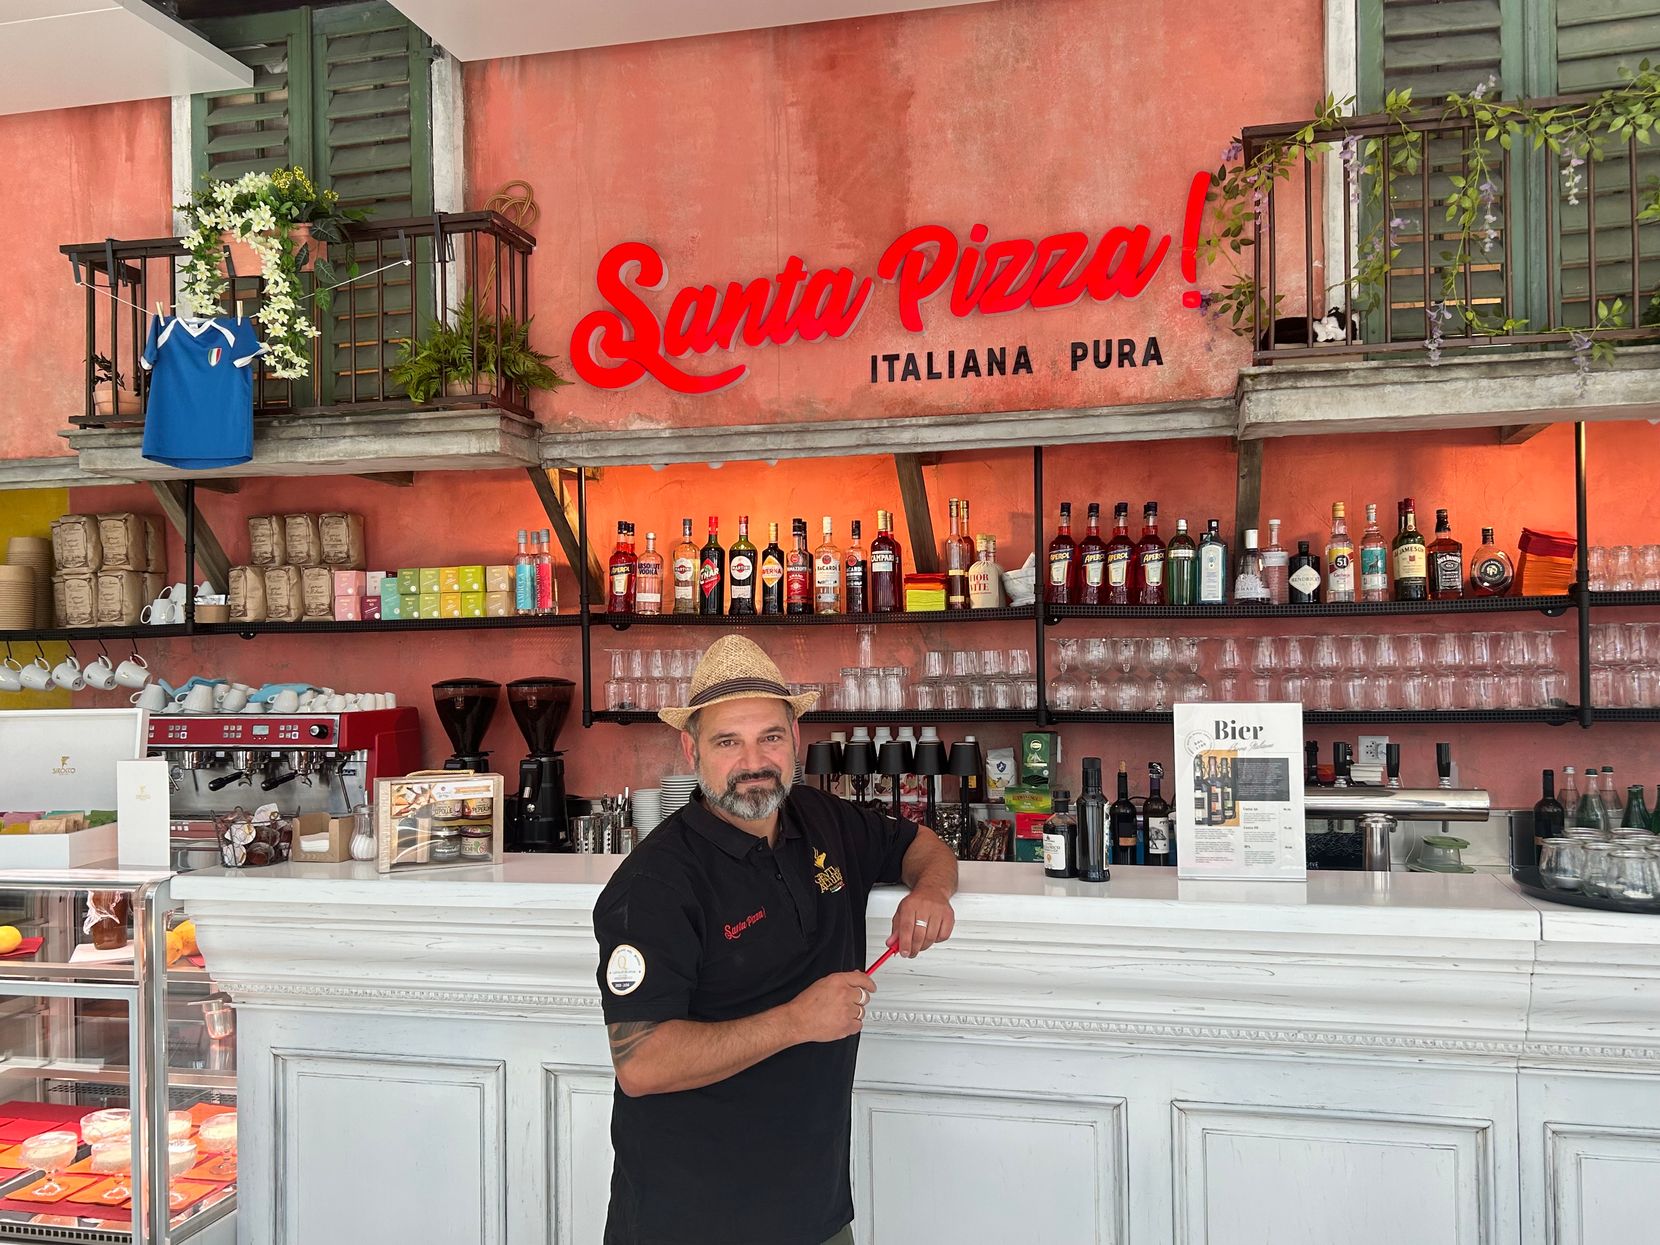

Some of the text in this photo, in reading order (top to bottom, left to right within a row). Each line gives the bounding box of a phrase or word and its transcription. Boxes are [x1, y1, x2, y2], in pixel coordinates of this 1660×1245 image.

[570, 241, 875, 394] Santa
[870, 336, 1164, 384] ITALIANA PURA
[1050, 552, 1070, 561] APEROL
[1108, 552, 1129, 563] APEROL
[1336, 557, 1348, 567] 51
[1214, 719, 1264, 740] Bier
[724, 921, 748, 940] Santa
